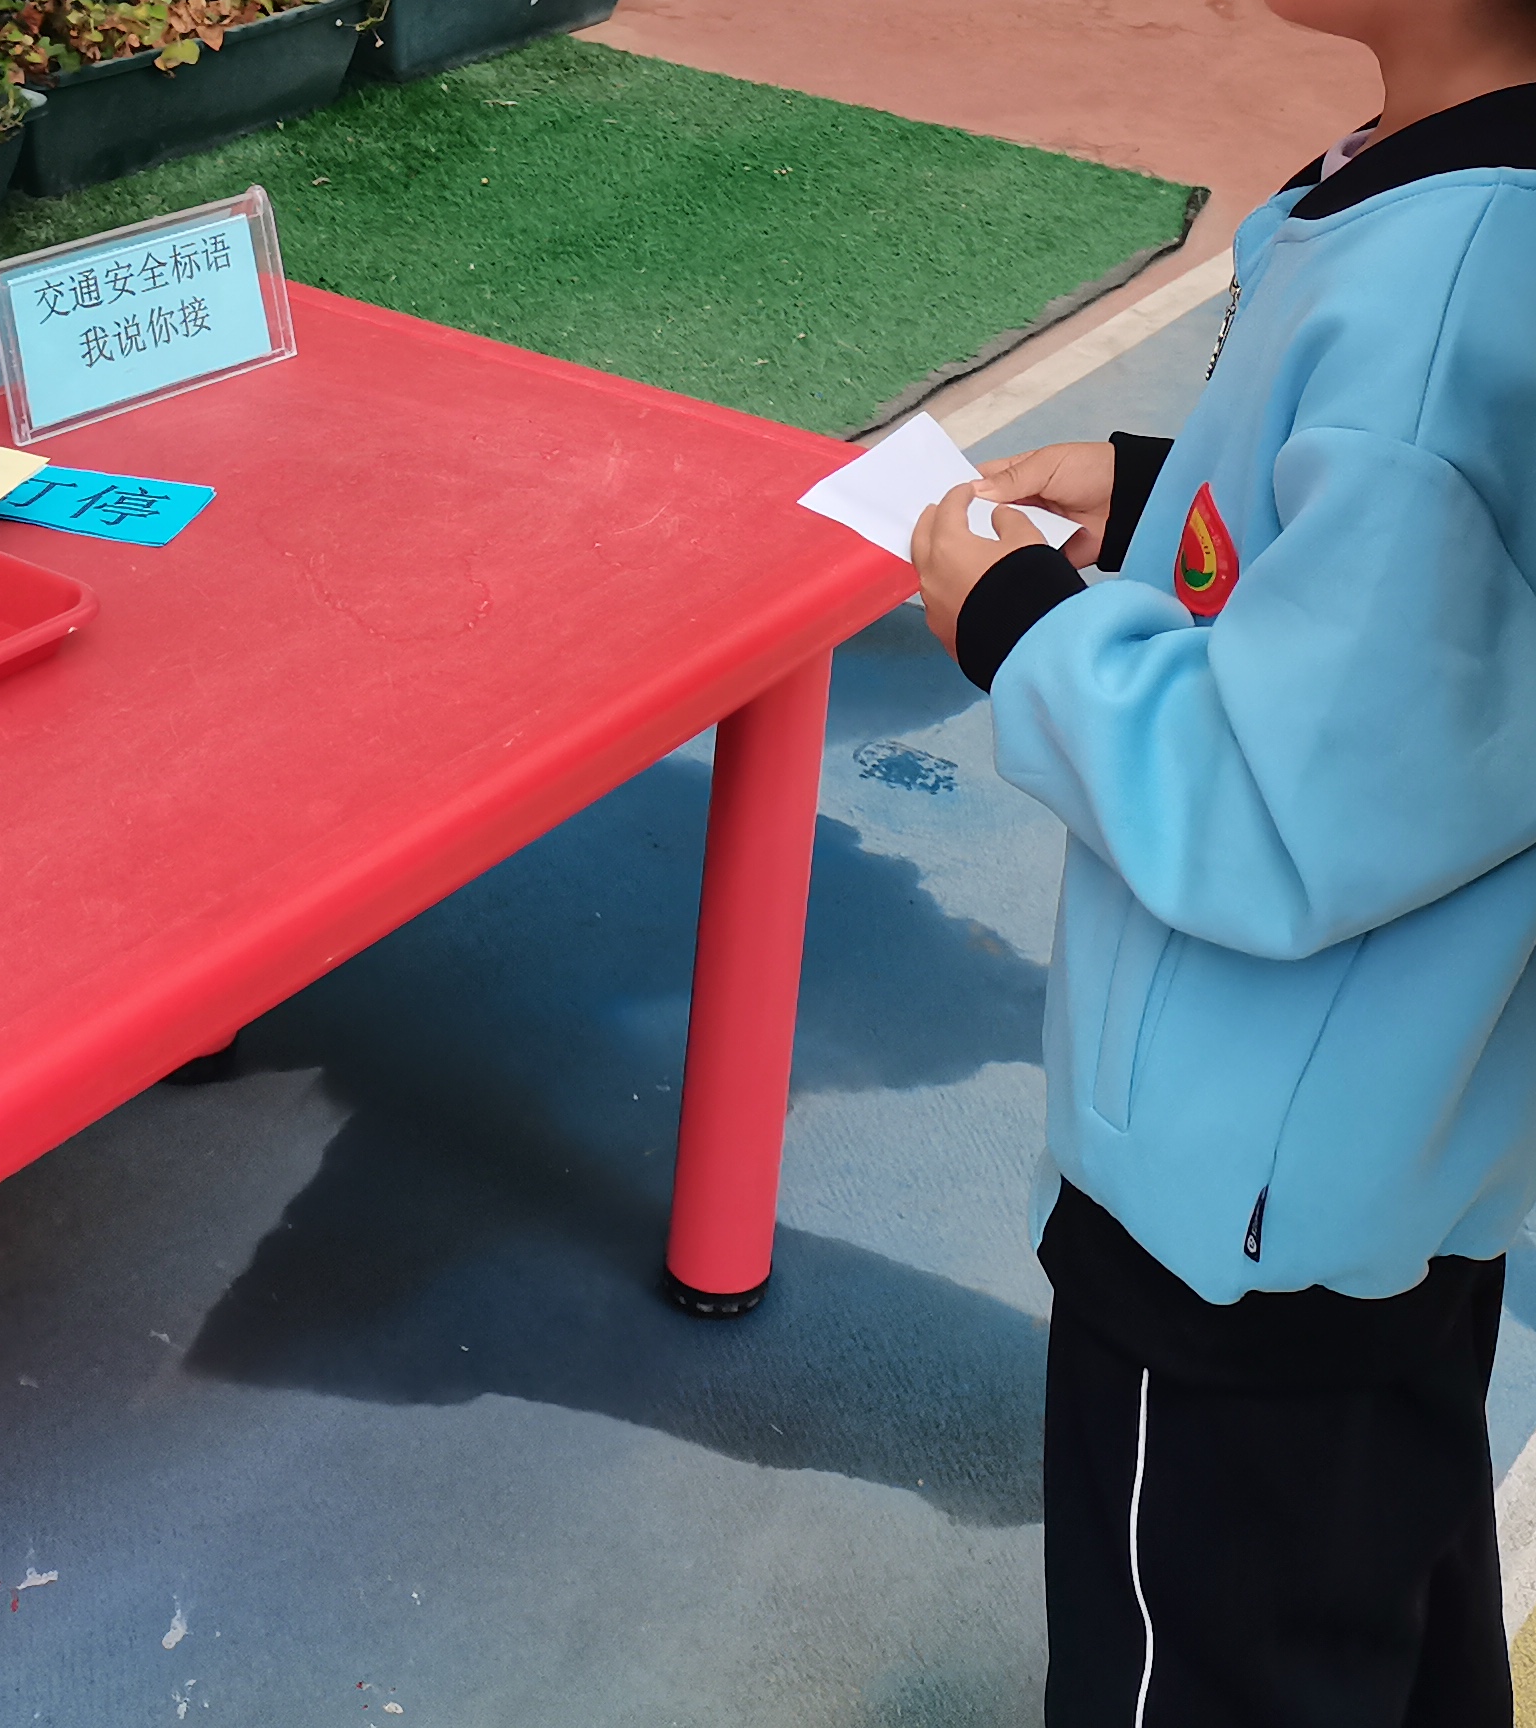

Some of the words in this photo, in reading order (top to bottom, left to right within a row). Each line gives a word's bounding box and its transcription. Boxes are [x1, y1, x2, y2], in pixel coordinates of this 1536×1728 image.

[33, 232, 232, 325] 交通安全标语
[79, 295, 212, 368] 我说你接
